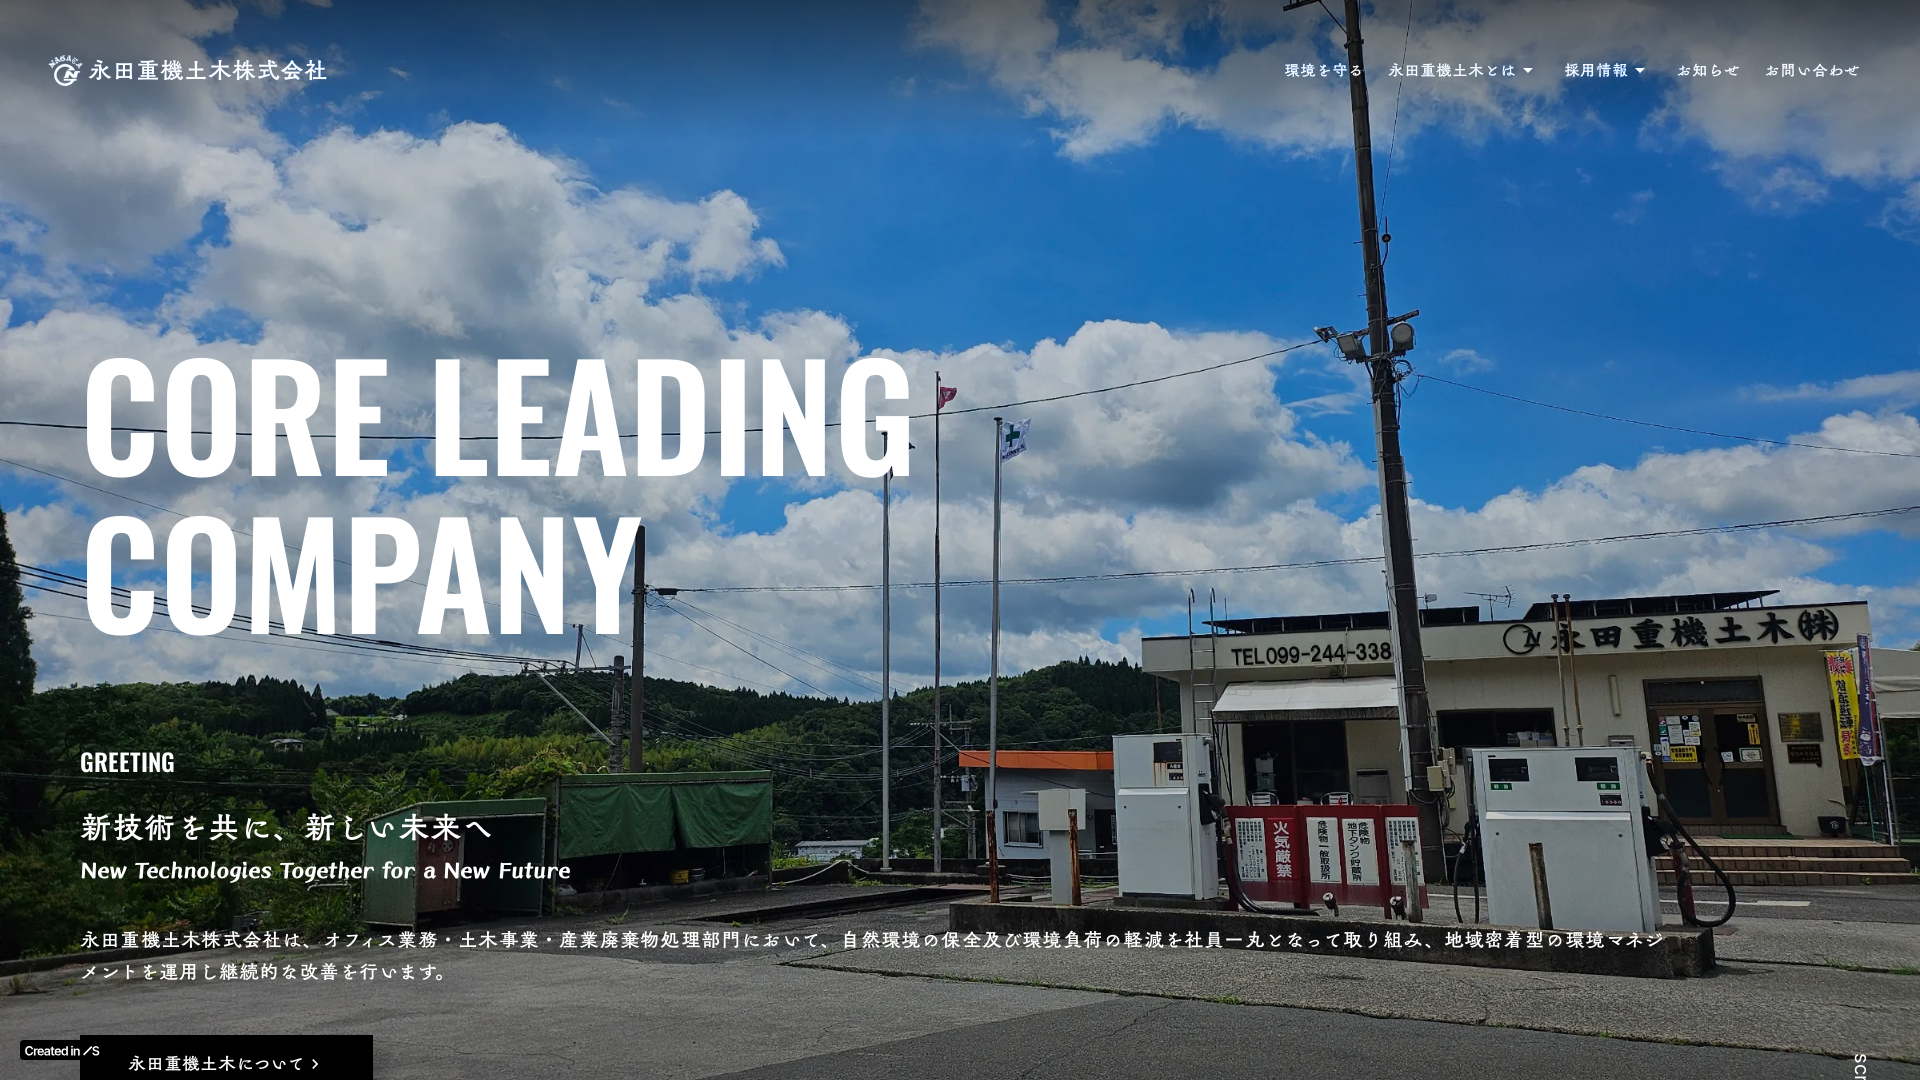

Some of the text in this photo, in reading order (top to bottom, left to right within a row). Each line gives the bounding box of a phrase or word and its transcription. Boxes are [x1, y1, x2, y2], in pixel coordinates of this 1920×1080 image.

[1231, 642, 1392, 666] TEL099-244-338
[1273, 820, 1292, 878] 火気厳禁
[1317, 820, 1331, 880] 危険物一般取扱所
[1347, 822, 1363, 881] 地下タンク貯蔵所
[1358, 822, 1371, 845] 危険物
